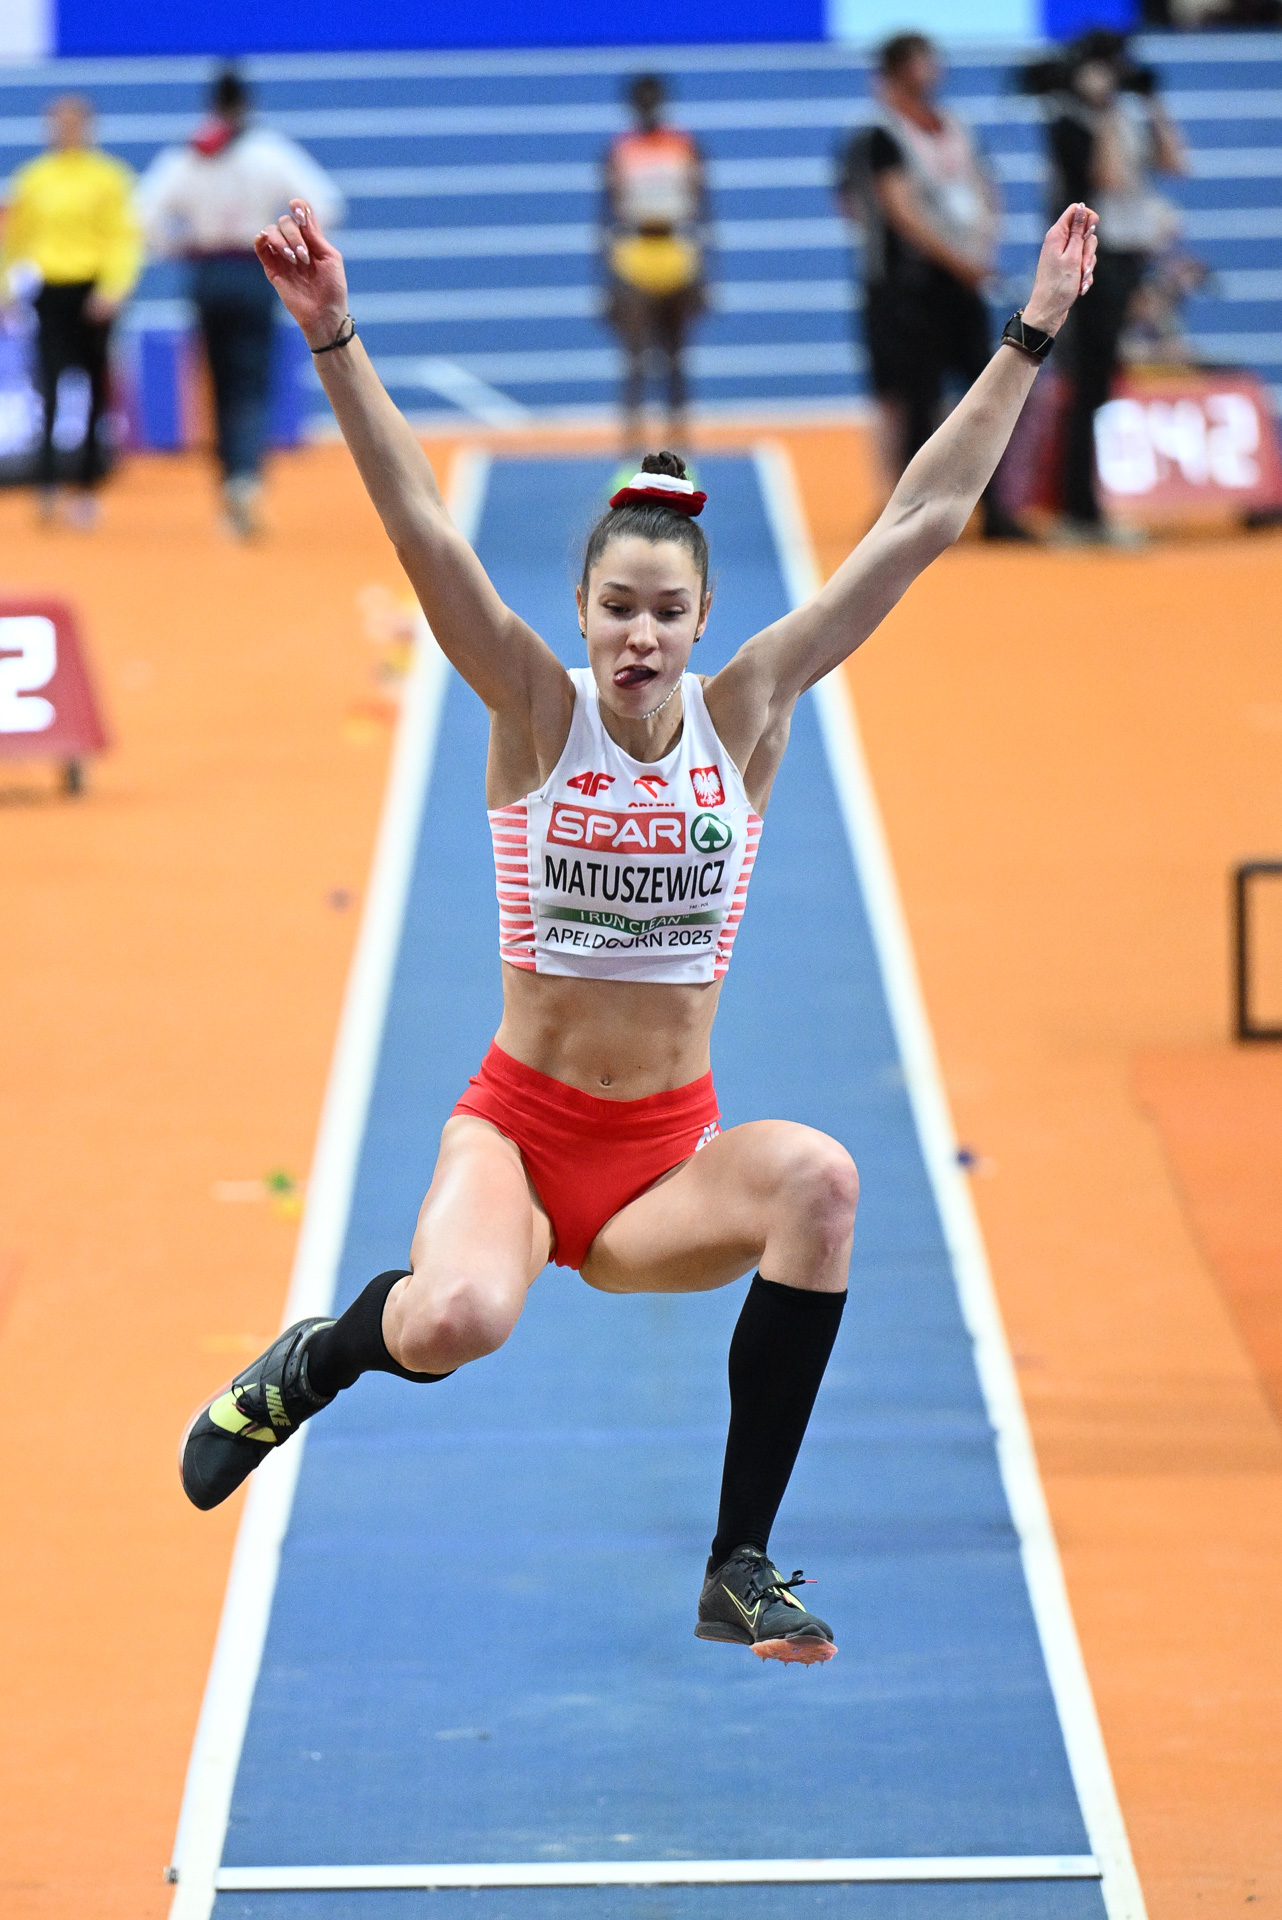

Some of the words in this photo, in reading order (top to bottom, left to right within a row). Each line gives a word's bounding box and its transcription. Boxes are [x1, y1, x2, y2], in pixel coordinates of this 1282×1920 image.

[0, 615, 57, 733] 2
[566, 771, 616, 797] 4F
[551, 811, 682, 848] SPAR
[545, 855, 725, 903] MATUSZEWICZ
[580, 910, 585, 921] I
[589, 911, 625, 930] RUN
[668, 929, 713, 947] 2025
[265, 1383, 292, 1427] NIKE
